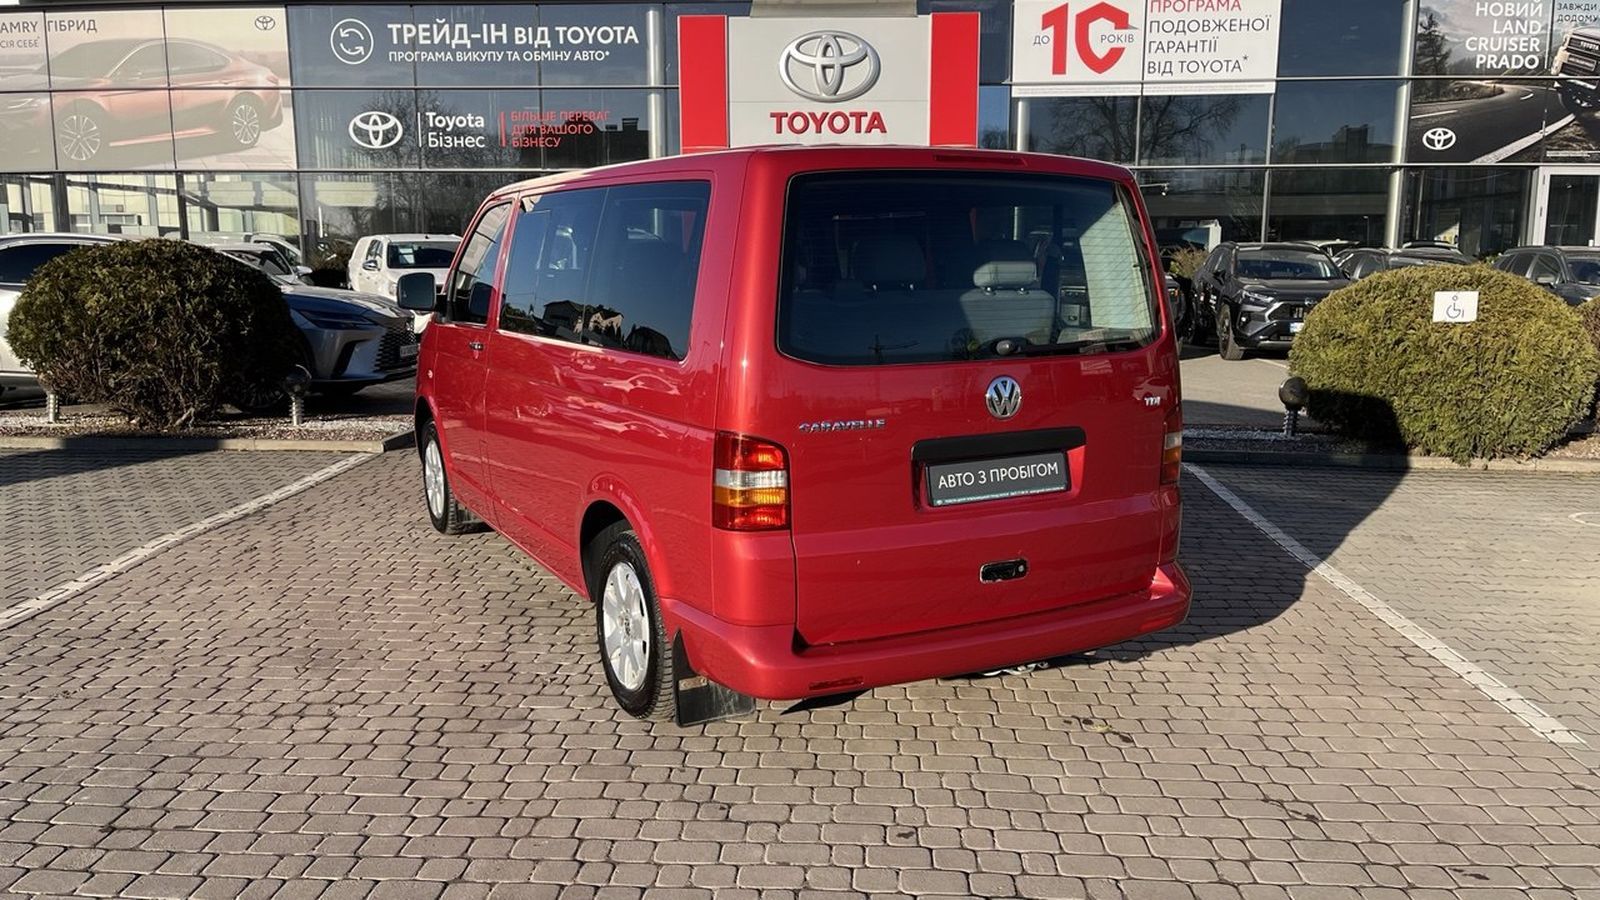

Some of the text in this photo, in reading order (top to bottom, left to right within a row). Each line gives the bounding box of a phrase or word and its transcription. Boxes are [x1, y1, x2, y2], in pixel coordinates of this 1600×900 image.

[1150, 0, 1242, 13] ПРОГРАМА
[1475, 0, 1543, 17] НОВИЙ
[1557, 3, 1598, 11] ЗАВЖДИ
[47, 19, 98, 33] ГІБРИД
[1149, 14, 1272, 35] ПОДОВЖЕНОЇ
[1557, 14, 1598, 24] ДОДОМУ
[387, 18, 639, 49] ТРЕЙД-ІН ВІД TOYOTA
[1493, 20, 1541, 34] LAND
[1033, 35, 1051, 46] ДО
[1100, 34, 1135, 43] РОКІВ
[1148, 36, 1219, 53] ГАРАНТІЇ
[1465, 36, 1540, 51] CRUISER
[388, 51, 453, 62] ПРОГРАМА
[456, 50, 504, 62] ВИКУПУ
[506, 51, 521, 61] ТА
[522, 51, 572, 62] ОБМІНУ
[1475, 54, 1539, 69] PRADO
[1147, 60, 1173, 76] ВІД
[425, 112, 484, 131] Toyota
[511, 111, 610, 121] БІЛЬШЕ ПЕРЕВАГ
[770, 111, 887, 134] TOYOTA
[512, 124, 593, 136] ДЛЯ ВАШОГО
[428, 132, 485, 148] Бізнес
[512, 137, 561, 148] БІЗНЕСУ
[799, 419, 886, 433] CARAVELLE
[938, 462, 1059, 489] АВТО З ПРОБІГОМ
